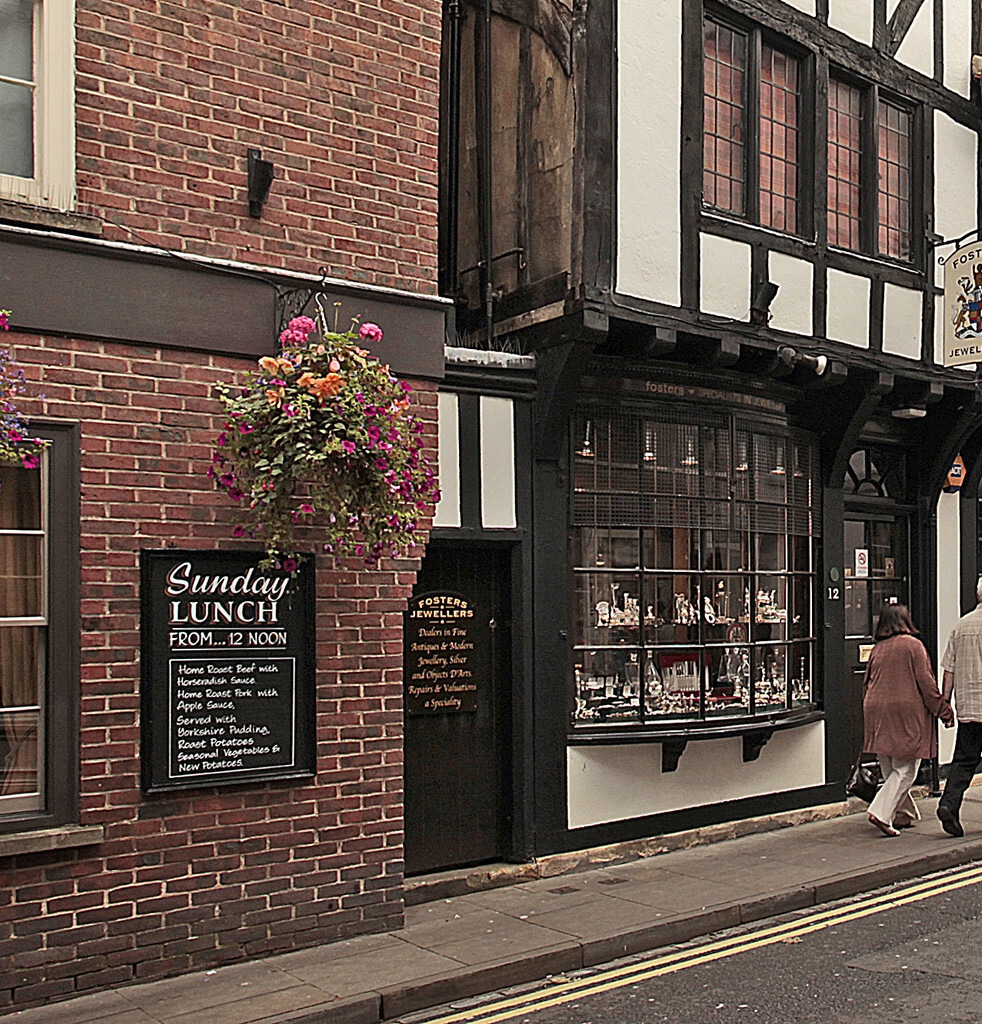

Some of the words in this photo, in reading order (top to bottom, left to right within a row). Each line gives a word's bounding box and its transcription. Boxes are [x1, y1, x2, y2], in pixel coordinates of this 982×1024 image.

[645, 380, 685, 396] fosters
[165, 562, 289, 602] Sunday
[828, 587, 840, 600] 12
[418, 596, 468, 609] FOSTERS
[168, 601, 278, 625] LUNCH
[410, 609, 474, 618] JEWELLERS
[418, 626, 442, 637] Dealers
[443, 628, 451, 636] in
[452, 627, 467, 636] Fine
[228, 632, 243, 646] 12
[248, 631, 287, 646] NOON
[411, 642, 440, 654] Antiques
[440, 641, 449, 651] &
[449, 639, 474, 651] Modern
[450, 653, 468, 664] Silver
[178, 664, 205, 675] Home
[207, 664, 233, 674] Roast
[236, 662, 257, 673] Beef
[259, 663, 279, 673] with
[177, 677, 227, 687] Horseradish
[412, 668, 426, 679] and
[426, 668, 449, 683] Objects
[177, 689, 203, 699] Home
[205, 688, 232, 698] Roast
[234, 688, 253, 697] Pork
[257, 688, 279, 697] with
[408, 685, 433, 698] Repairs
[434, 684, 442, 693] &
[443, 681, 477, 692] Valuations
[176, 700, 203, 713] Apple
[176, 715, 212, 726] Served
[215, 714, 237, 724] with
[177, 726, 226, 737] Yorkshire
[177, 739, 207, 750] Roast
[210, 737, 254, 748] Potatoes
[177, 748, 219, 762] Seasonal
[223, 746, 270, 759] Vegetables
[272, 744, 281, 754] &
[178, 762, 200, 773] New
